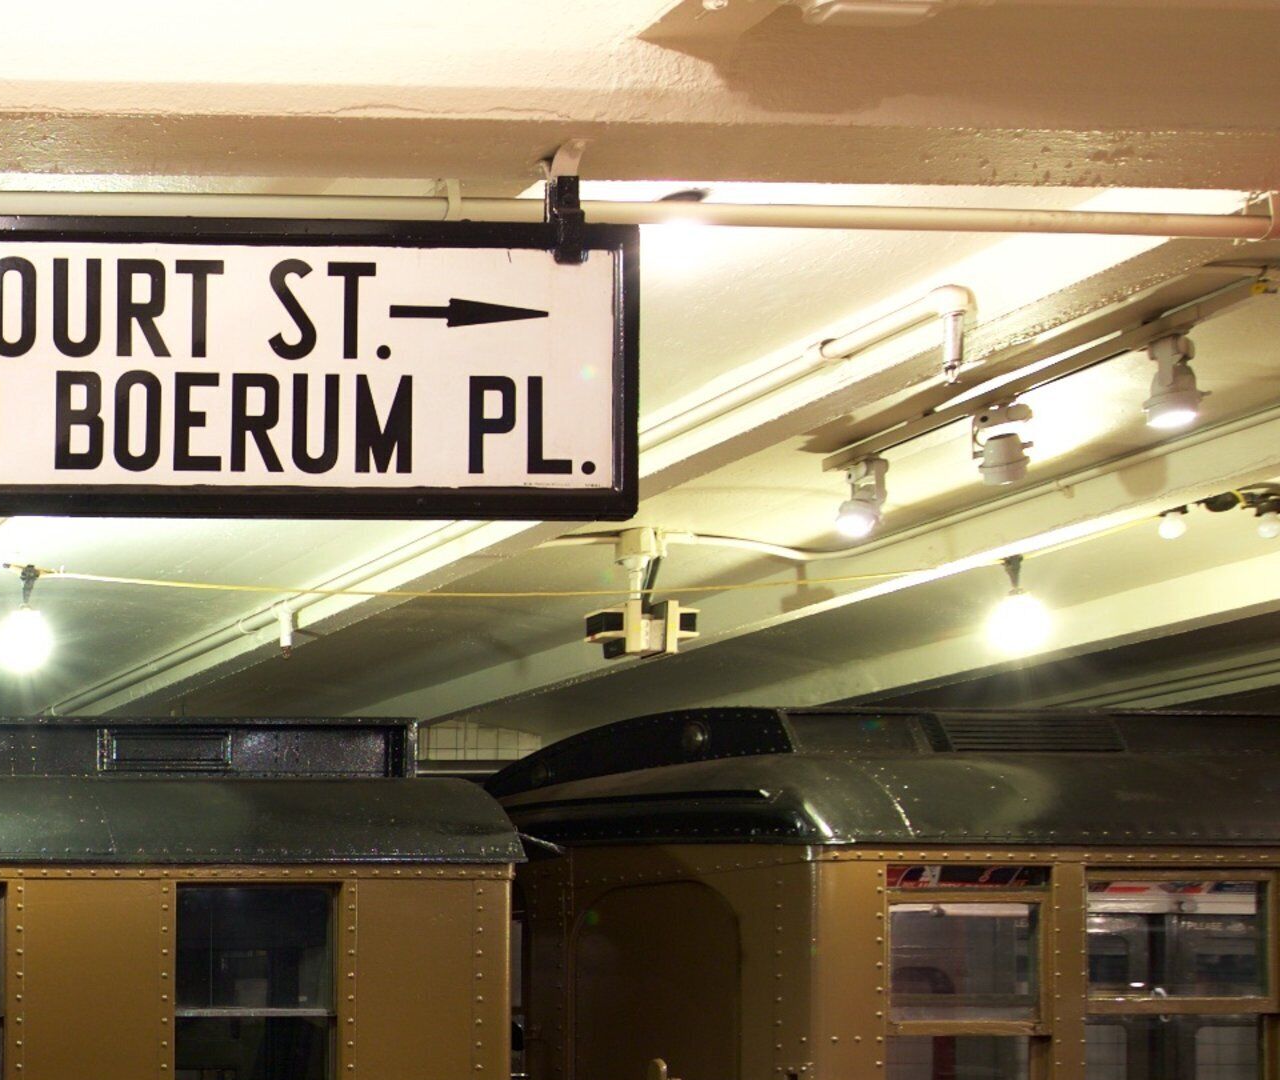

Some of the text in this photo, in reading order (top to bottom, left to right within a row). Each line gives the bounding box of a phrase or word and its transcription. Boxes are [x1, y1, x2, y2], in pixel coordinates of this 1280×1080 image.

[269, 259, 392, 361] ST.
[55, 371, 412, 473] BOERUM
[469, 376, 597, 475] PL.
